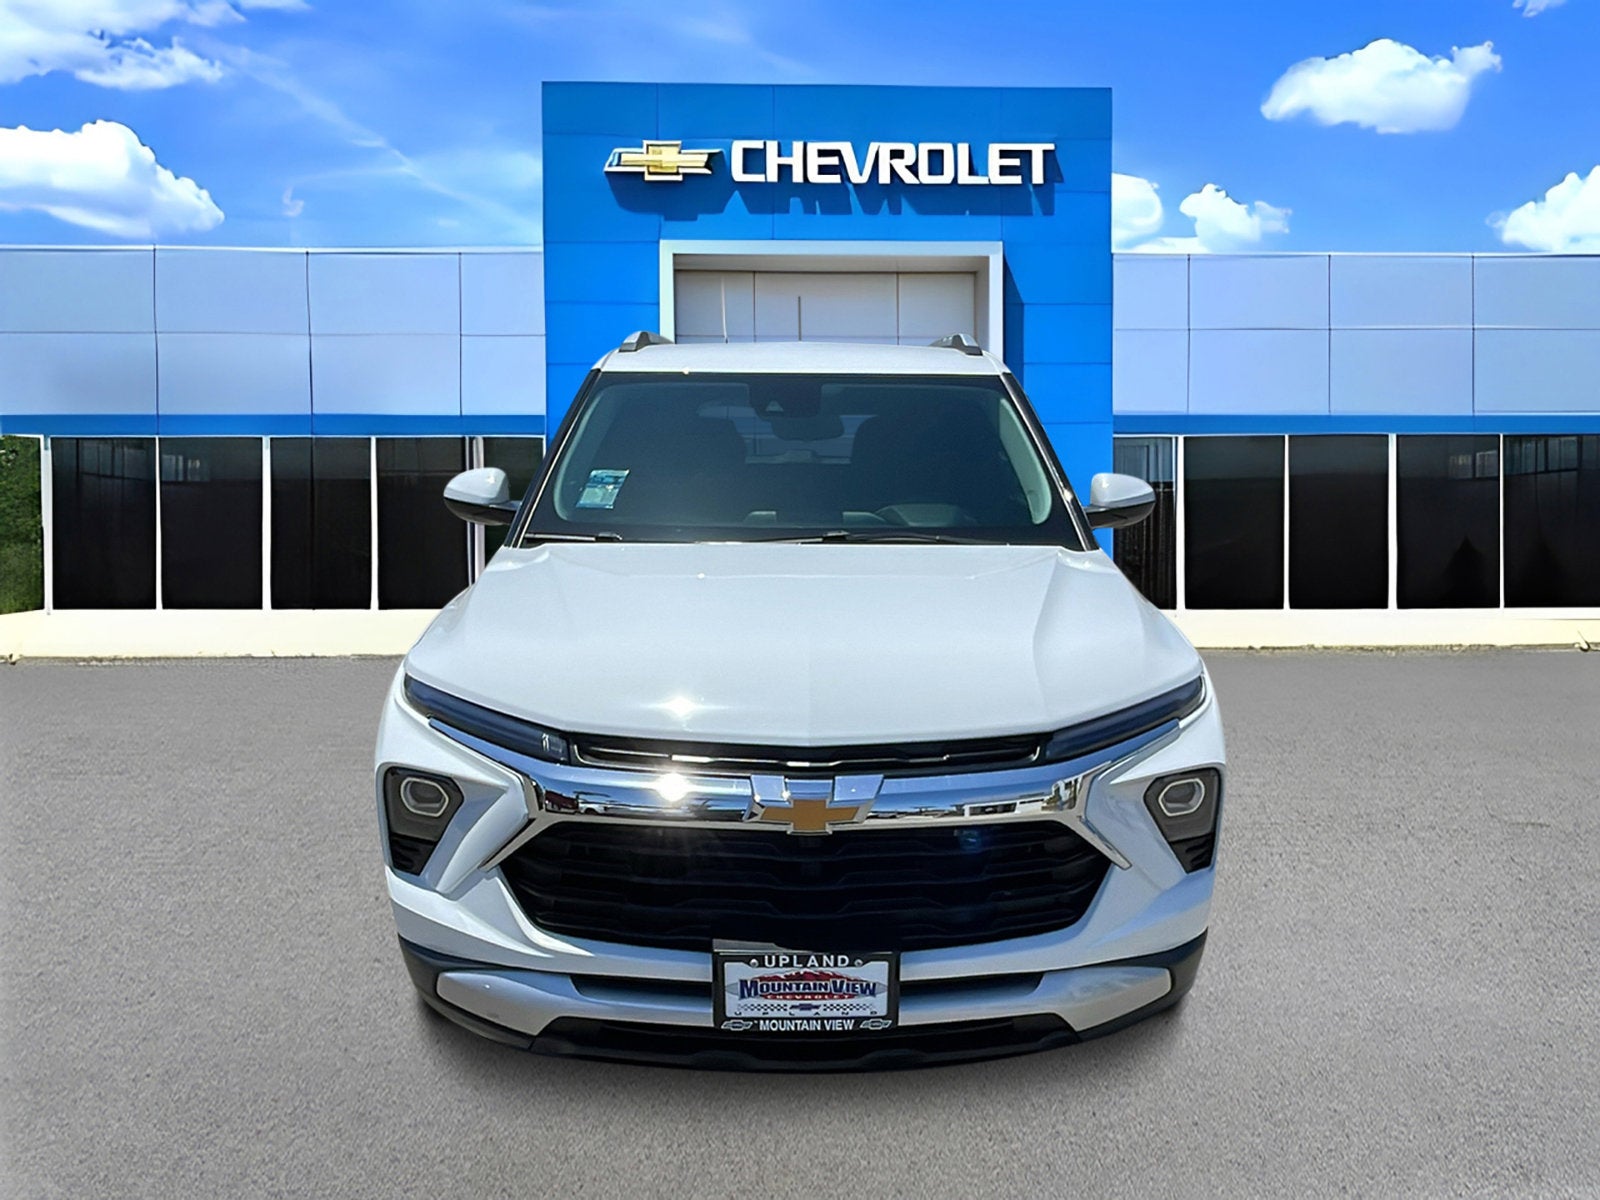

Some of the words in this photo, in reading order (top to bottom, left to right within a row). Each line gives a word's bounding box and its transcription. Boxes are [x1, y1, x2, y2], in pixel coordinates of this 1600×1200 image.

[731, 140, 1055, 185] CHEVROLET
[764, 955, 850, 967] UPLAND
[739, 979, 830, 1000] MOUNTAIN
[830, 979, 877, 998] VIEW
[759, 1020, 822, 1031] MOUNTAIN
[824, 1020, 855, 1031] VIEW
